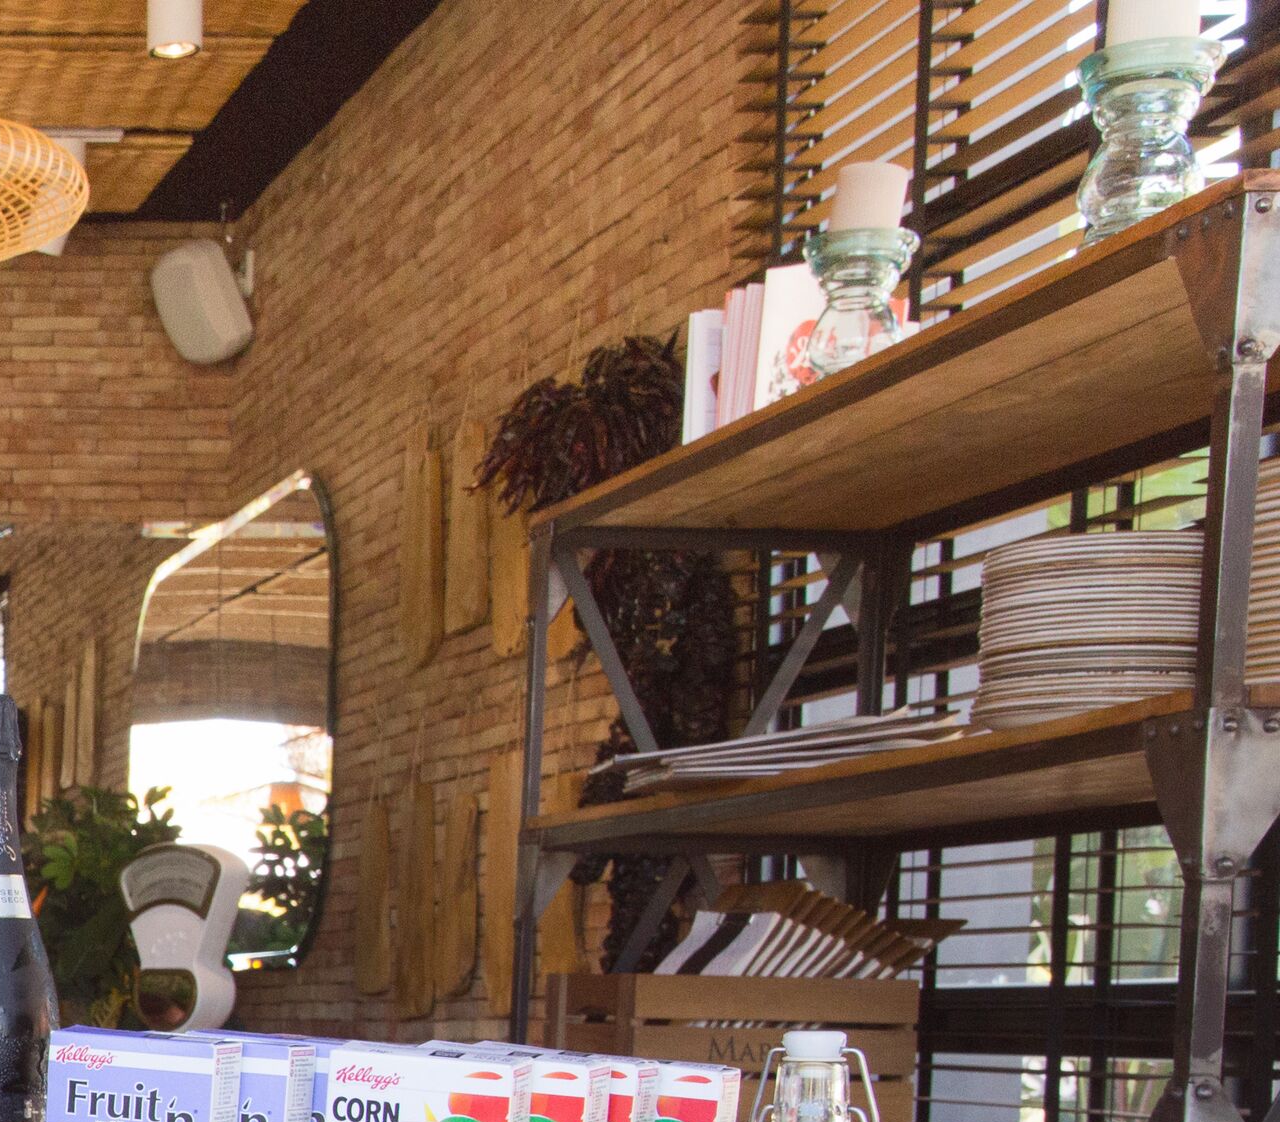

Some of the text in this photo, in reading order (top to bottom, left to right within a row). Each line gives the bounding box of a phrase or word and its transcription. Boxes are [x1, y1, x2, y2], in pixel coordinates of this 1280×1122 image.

[56, 1045, 115, 1069] Kellogg's
[336, 1065, 401, 1090] Kellogg's
[66, 1079, 161, 1122] Fruit
